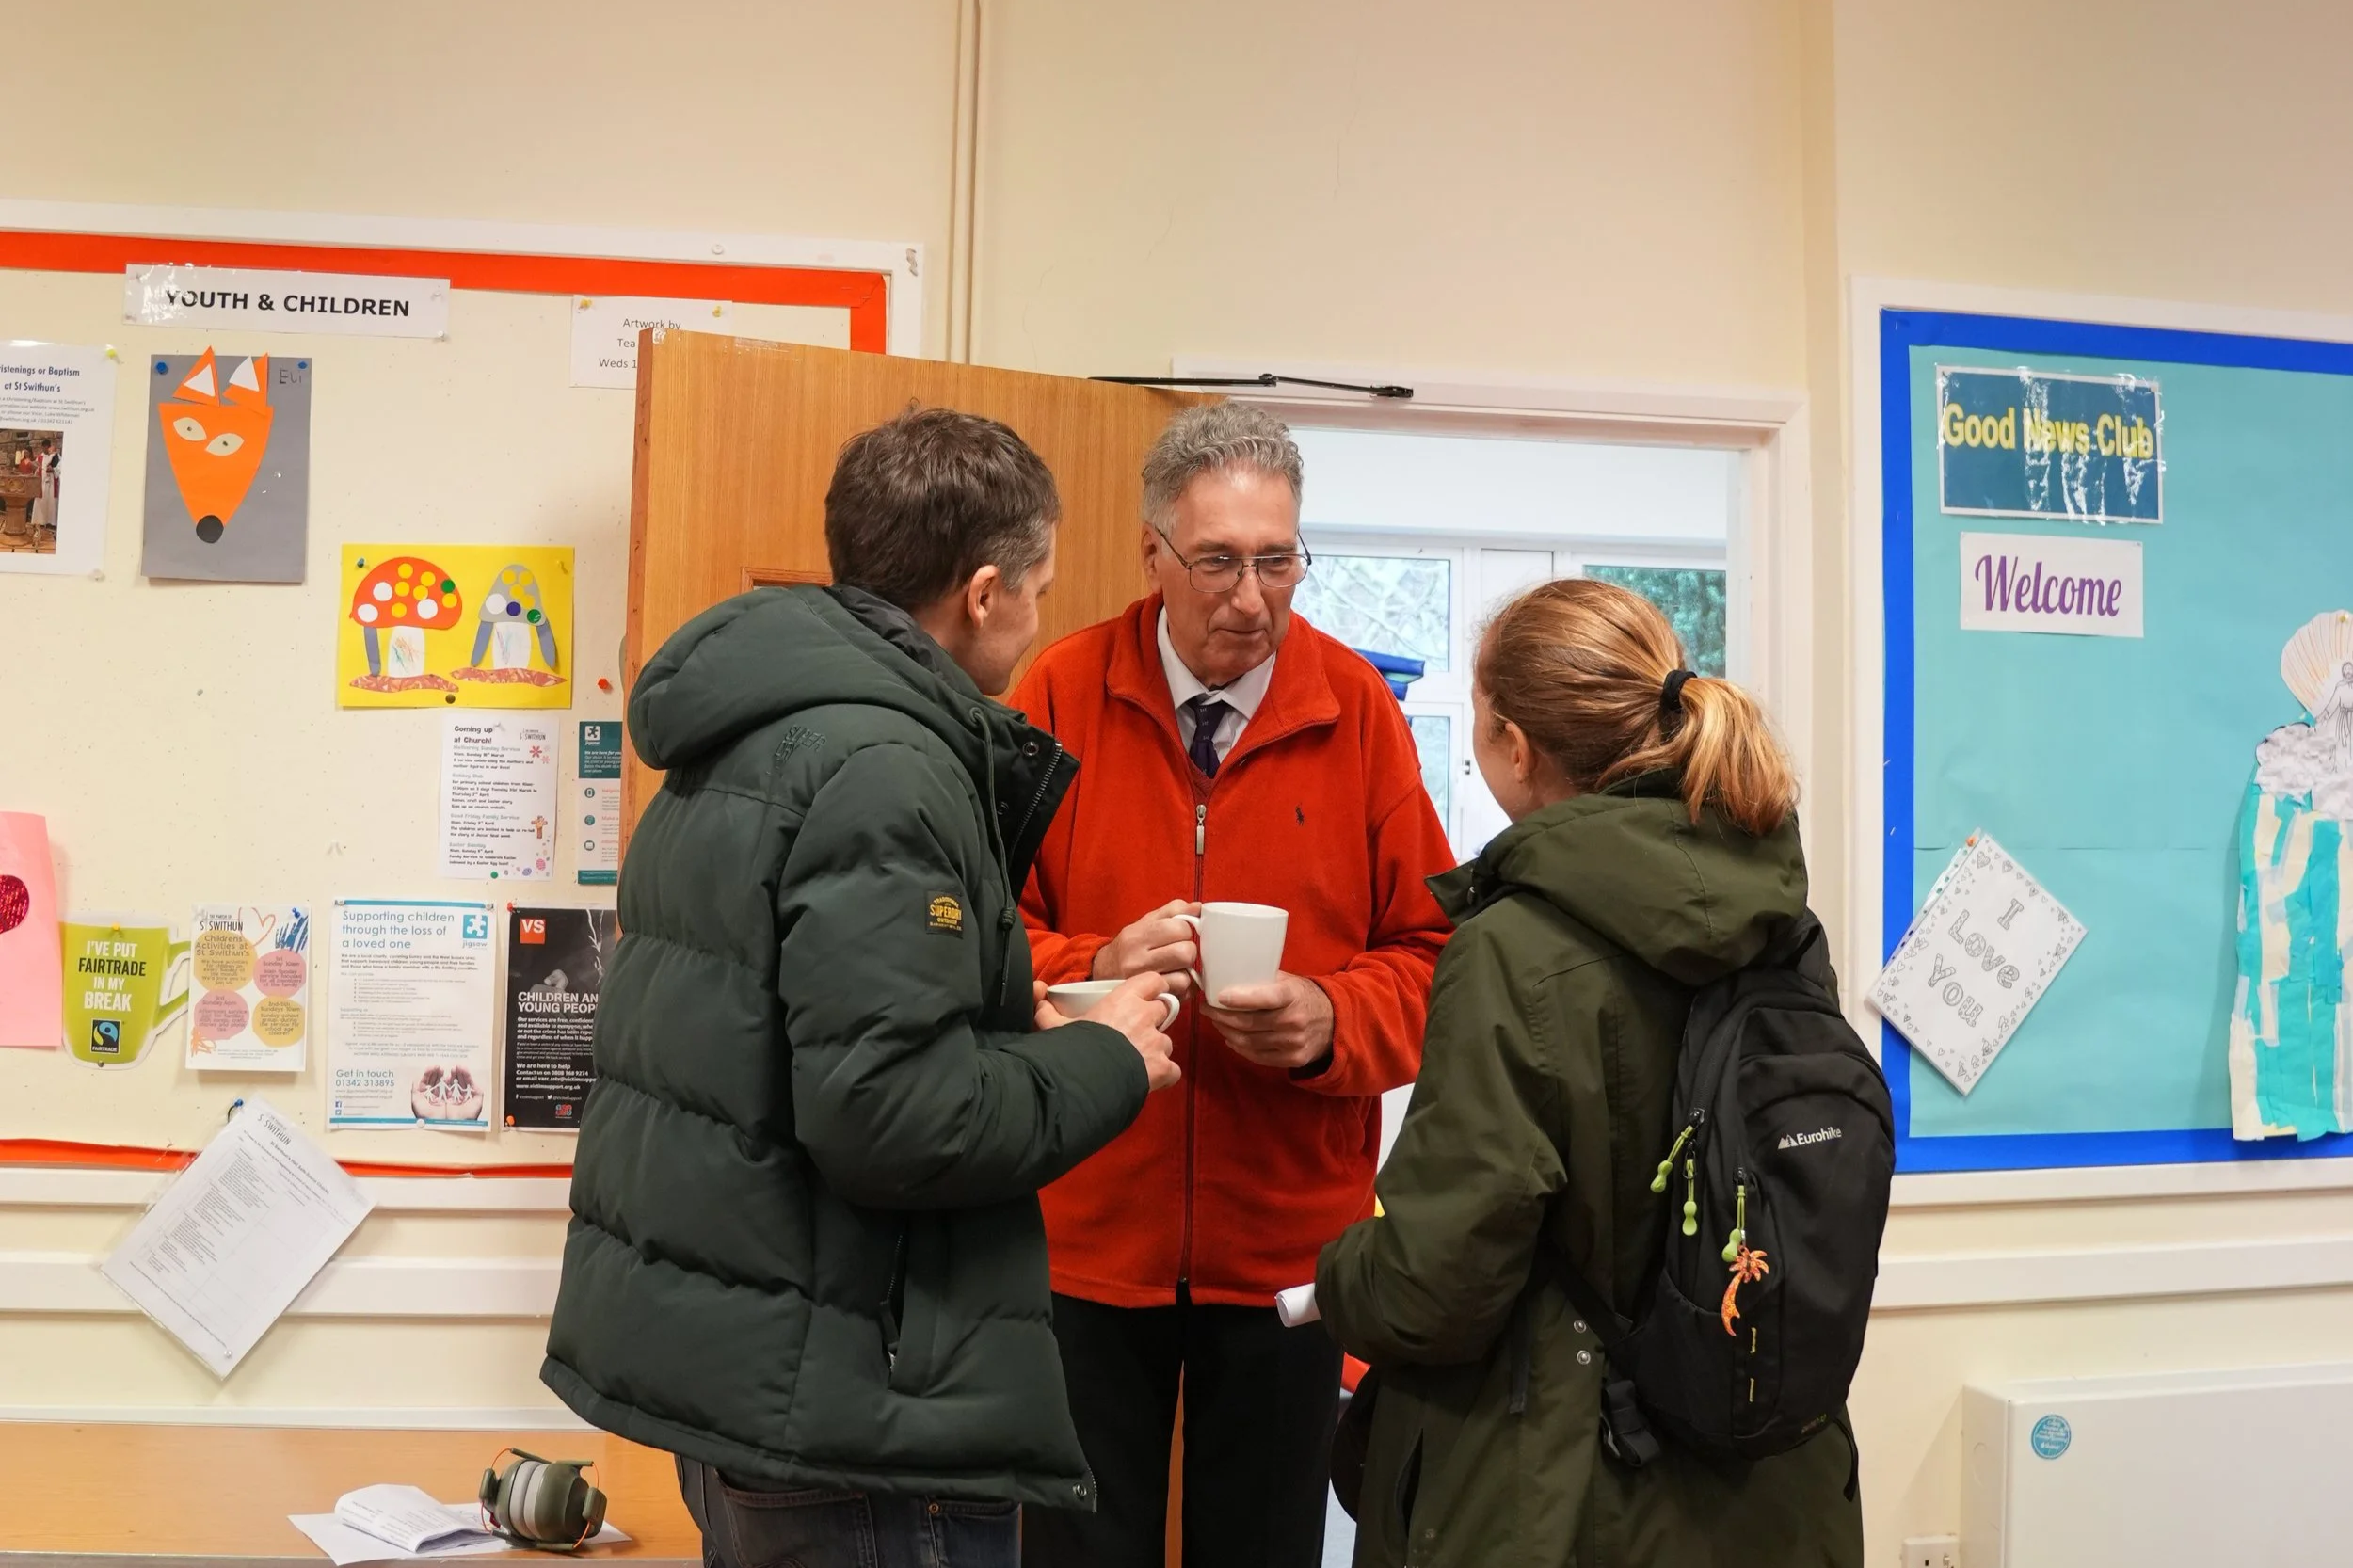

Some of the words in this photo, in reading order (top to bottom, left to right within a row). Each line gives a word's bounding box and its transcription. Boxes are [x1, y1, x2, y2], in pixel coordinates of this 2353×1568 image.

[166, 290, 248, 309] YOUTH
[258, 294, 275, 311] &
[284, 295, 409, 316] CHILDREN
[623, 318, 664, 329] Artwork
[599, 359, 628, 368] Weds
[49, 366, 80, 376] Baptism
[24, 382, 60, 392] Swithun's
[1943, 403, 2015, 450] Good
[2023, 408, 2090, 455] News
[2096, 413, 2153, 459] Club
[1975, 554, 2121, 617] Welcome
[454, 726, 481, 734] Coming
[343, 910, 405, 923] Supporting
[408, 912, 455, 922] children
[1997, 897, 2025, 930] I
[209, 921, 244, 931] SWITHUN
[342, 924, 387, 936] through
[390, 925, 408, 936] the
[411, 926, 433, 936] loss
[436, 925, 448, 936] of
[521, 920, 545, 933] VS
[86, 940, 109, 956] I'VE
[113, 942, 137, 958] PUT
[352, 938, 386, 948] loved
[389, 940, 411, 949] one
[78, 957, 147, 976] FAIRTRADE
[93, 976, 104, 989] IN
[108, 977, 125, 990] MY
[518, 991, 579, 1002] CHILDREN
[1928, 953, 1983, 1028] You
[84, 990, 132, 1012] BREAK
[518, 1001, 560, 1013] YOUNG
[336, 1069, 354, 1078] Get
[355, 1069, 364, 1078] in
[366, 1069, 394, 1078] touch
[264, 1119, 291, 1145] SWITHUN
[1796, 1127, 1842, 1145] Eurohike
